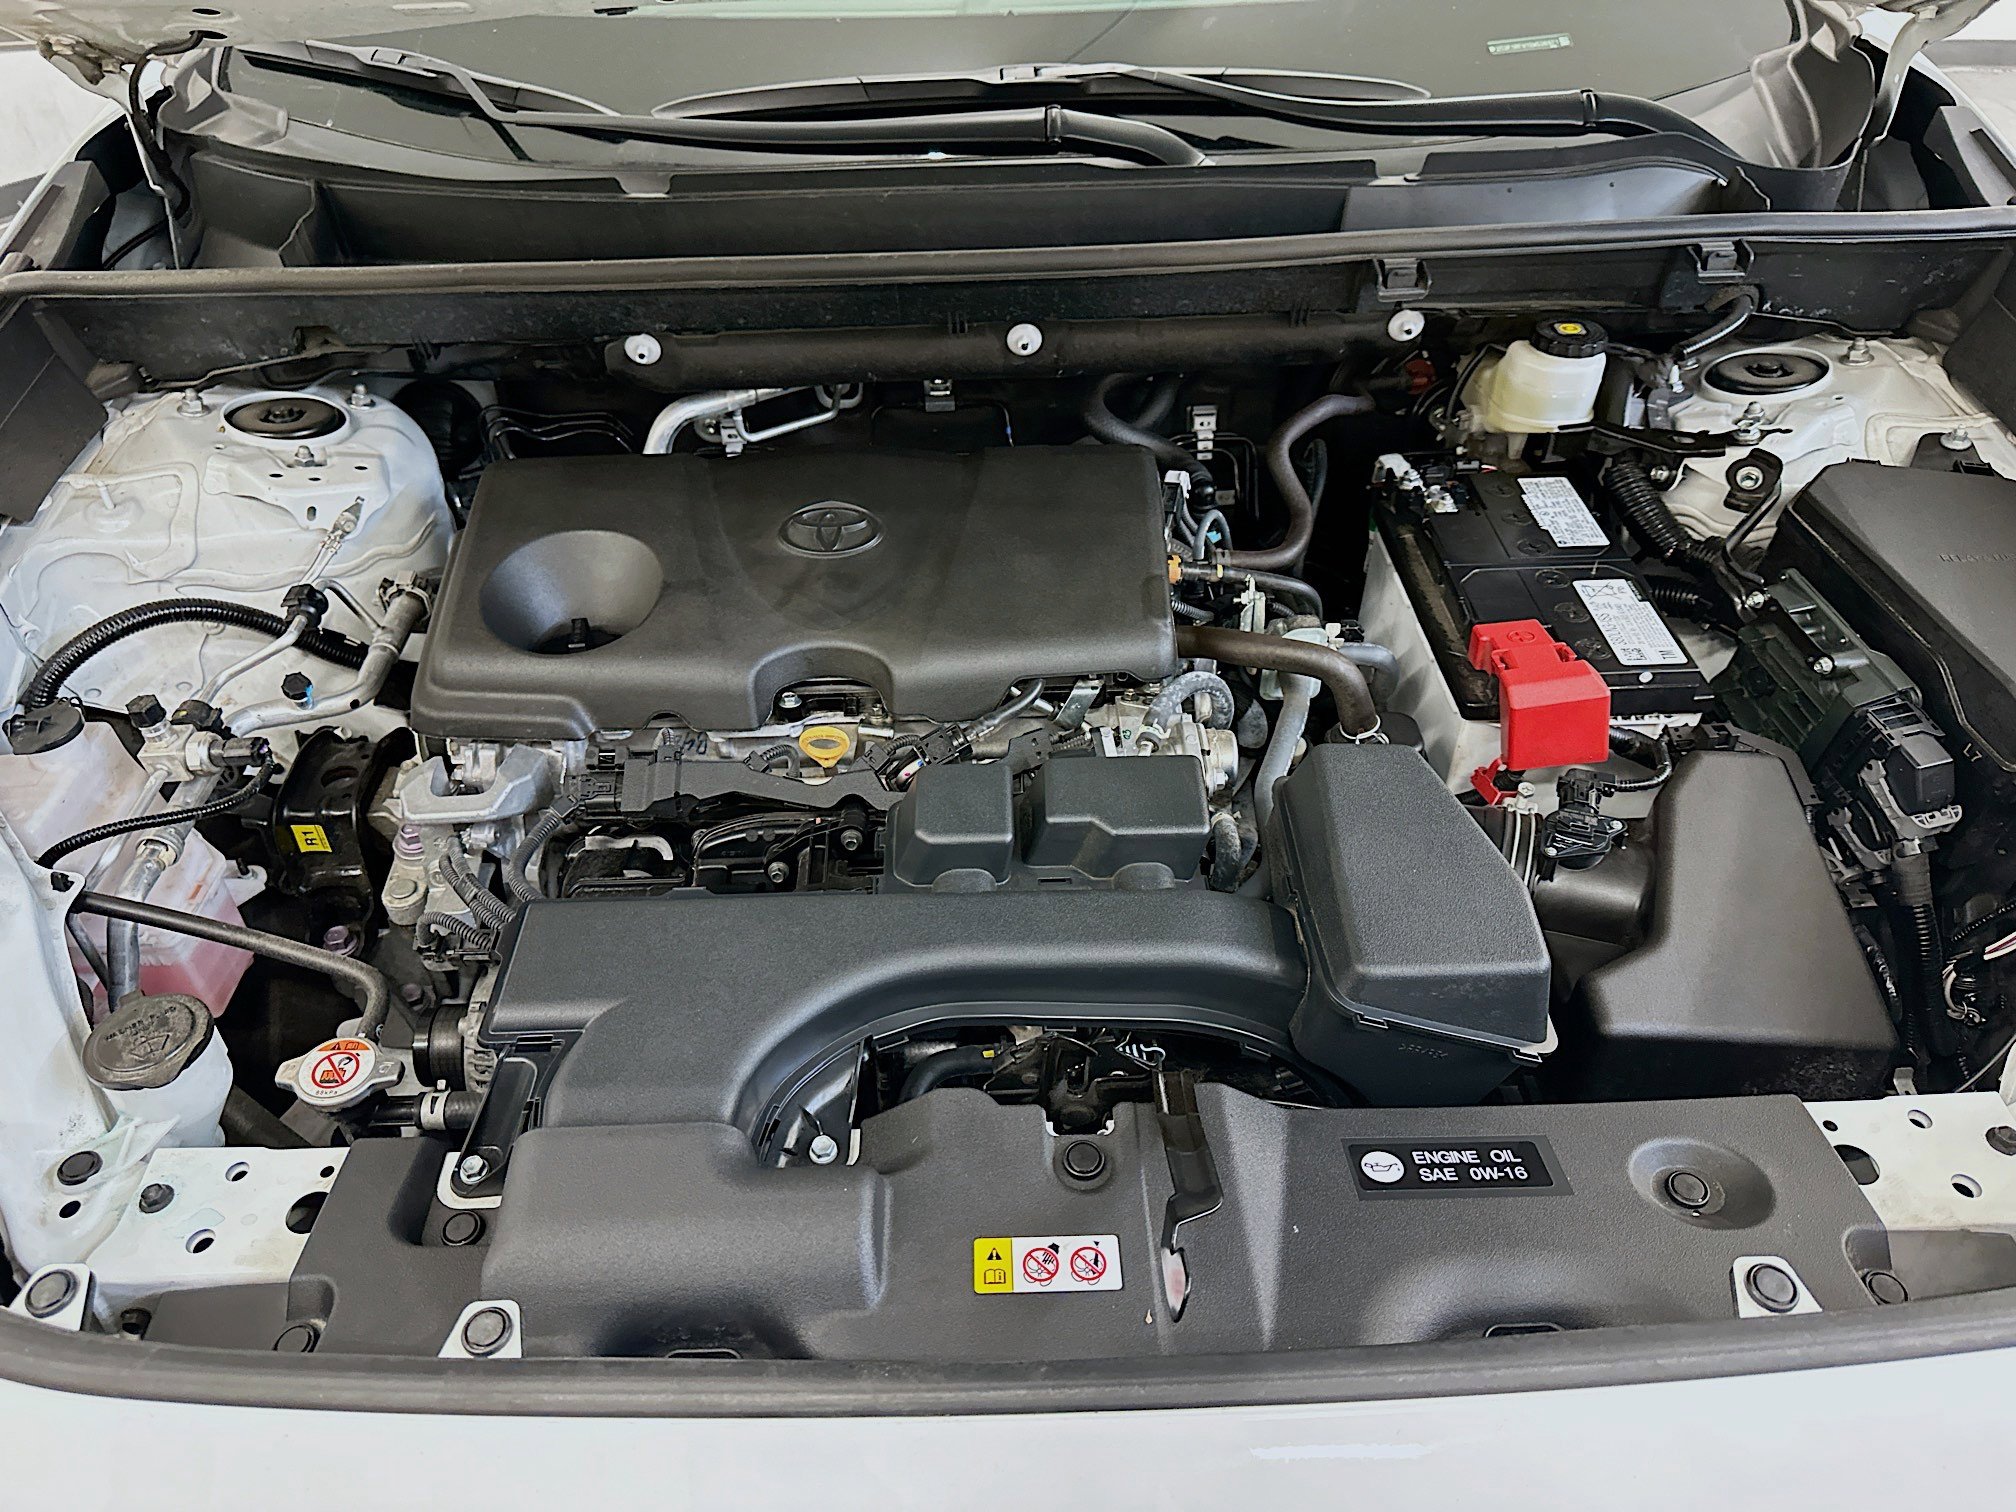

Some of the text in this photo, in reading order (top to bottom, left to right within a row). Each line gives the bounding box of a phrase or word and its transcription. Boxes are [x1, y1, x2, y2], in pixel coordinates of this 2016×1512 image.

[1963, 743, 1983, 762] L7
[302, 831, 318, 845] R1
[1412, 1149, 1522, 1165] ENGINE OIL
[1420, 1166, 1529, 1182] SAE 0W-16
